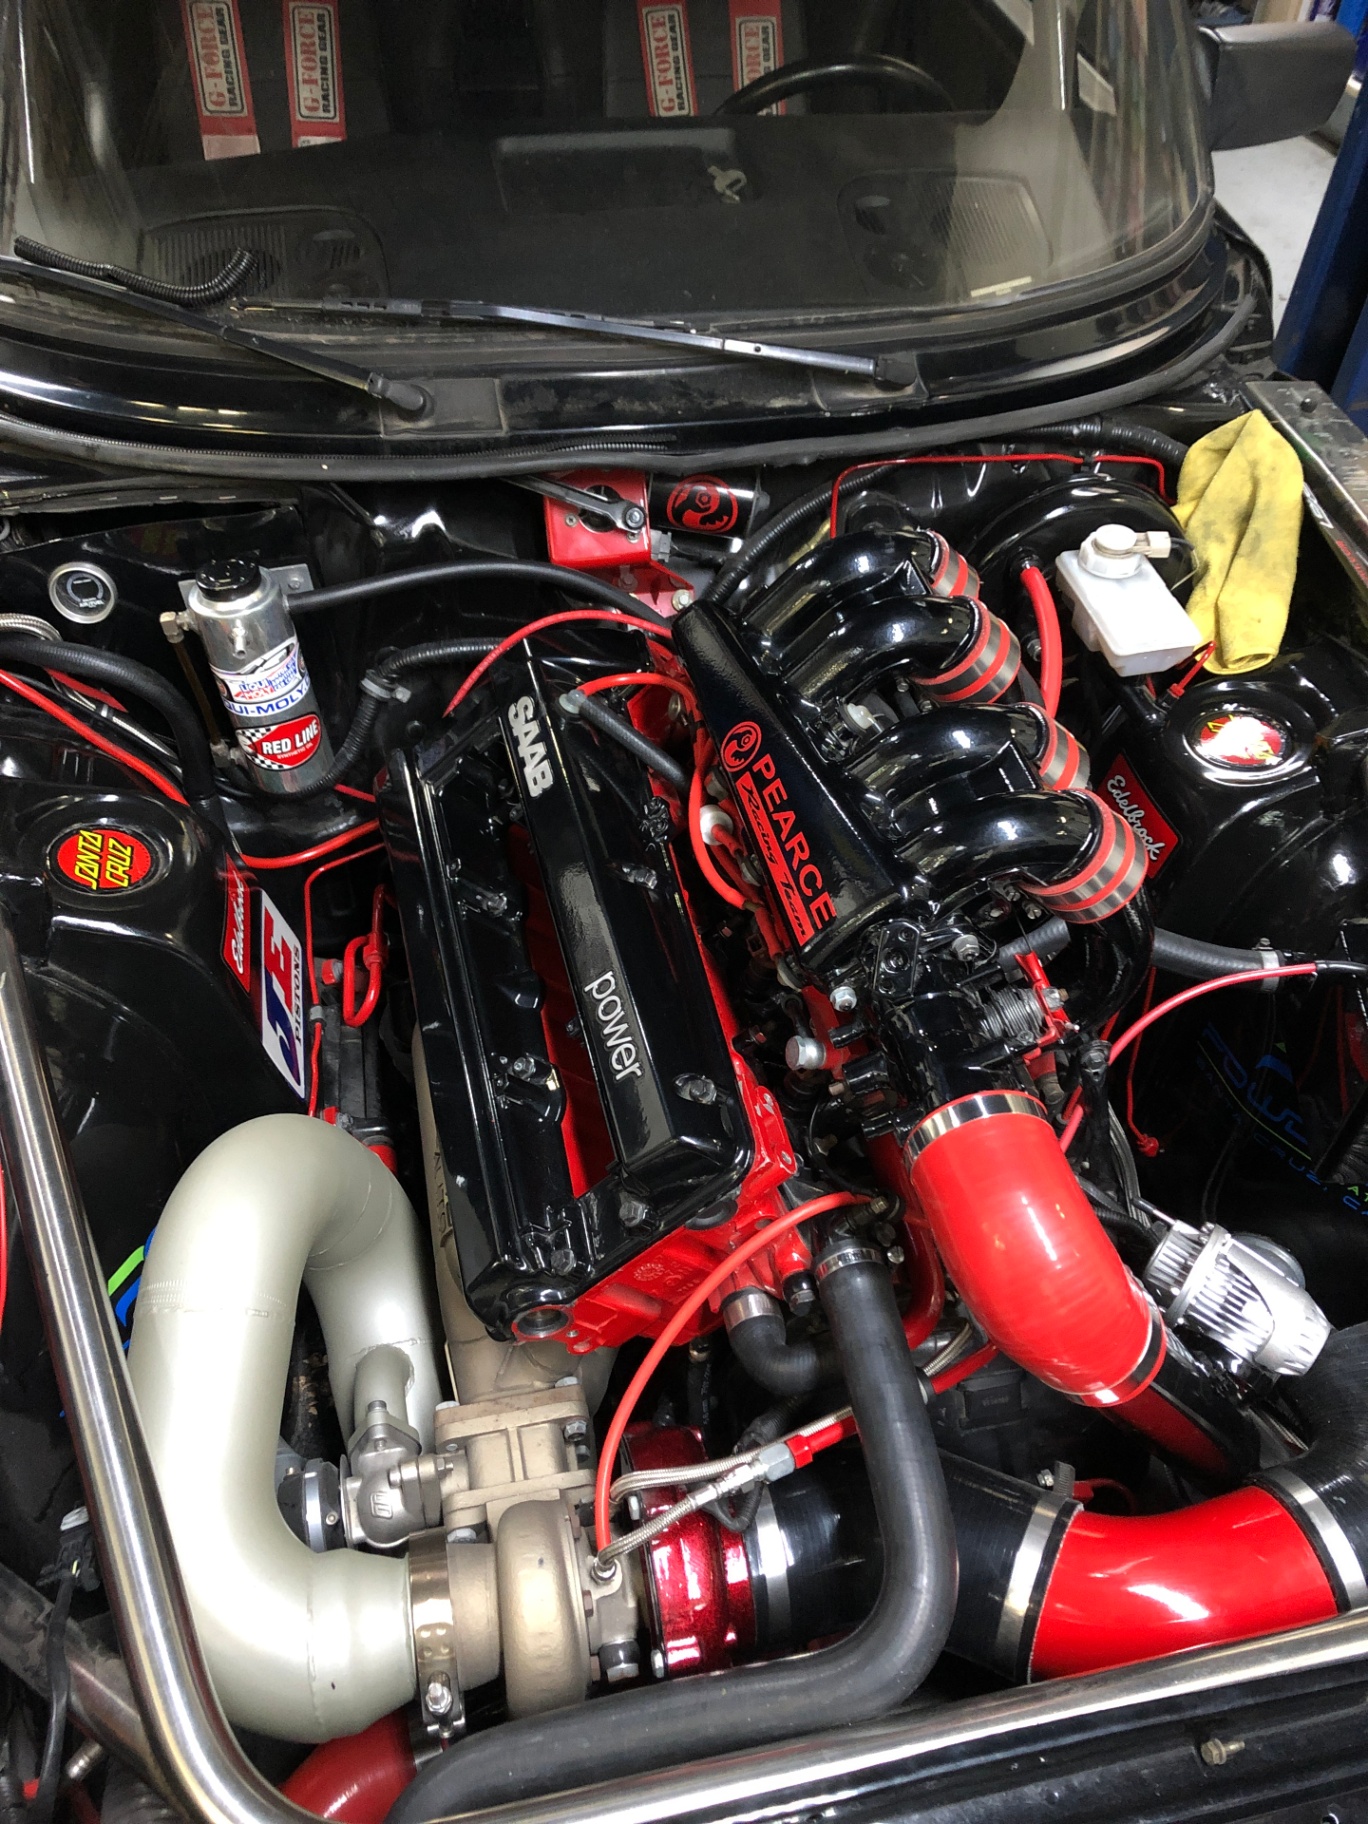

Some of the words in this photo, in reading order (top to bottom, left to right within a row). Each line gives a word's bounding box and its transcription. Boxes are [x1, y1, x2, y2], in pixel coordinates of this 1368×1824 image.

[196, 6, 227, 107] G-FORCE
[215, 7, 229, 46] GEAR
[316, 13, 328, 52] GEAR
[667, 14, 679, 52] GEAR
[744, 24, 762, 83] ORCE
[221, 49, 238, 107] RACING
[299, 12, 321, 113] G-FORCE
[319, 55, 332, 114] RACING
[651, 14, 677, 113] G-FORCE
[672, 55, 686, 111] RACING
[261, 737, 292, 755] RED
[294, 718, 319, 749] LINE
[508, 696, 554, 798] SAAB
[752, 753, 837, 930] PEARCE
[1106, 774, 1167, 862] Edelbrock
[74, 829, 103, 891] SANTA
[105, 837, 132, 888] CRUZ
[741, 783, 778, 866] Racing
[780, 871, 807, 938] Team
[293, 944, 302, 1046] PISTONS
[584, 970, 643, 1082] power
